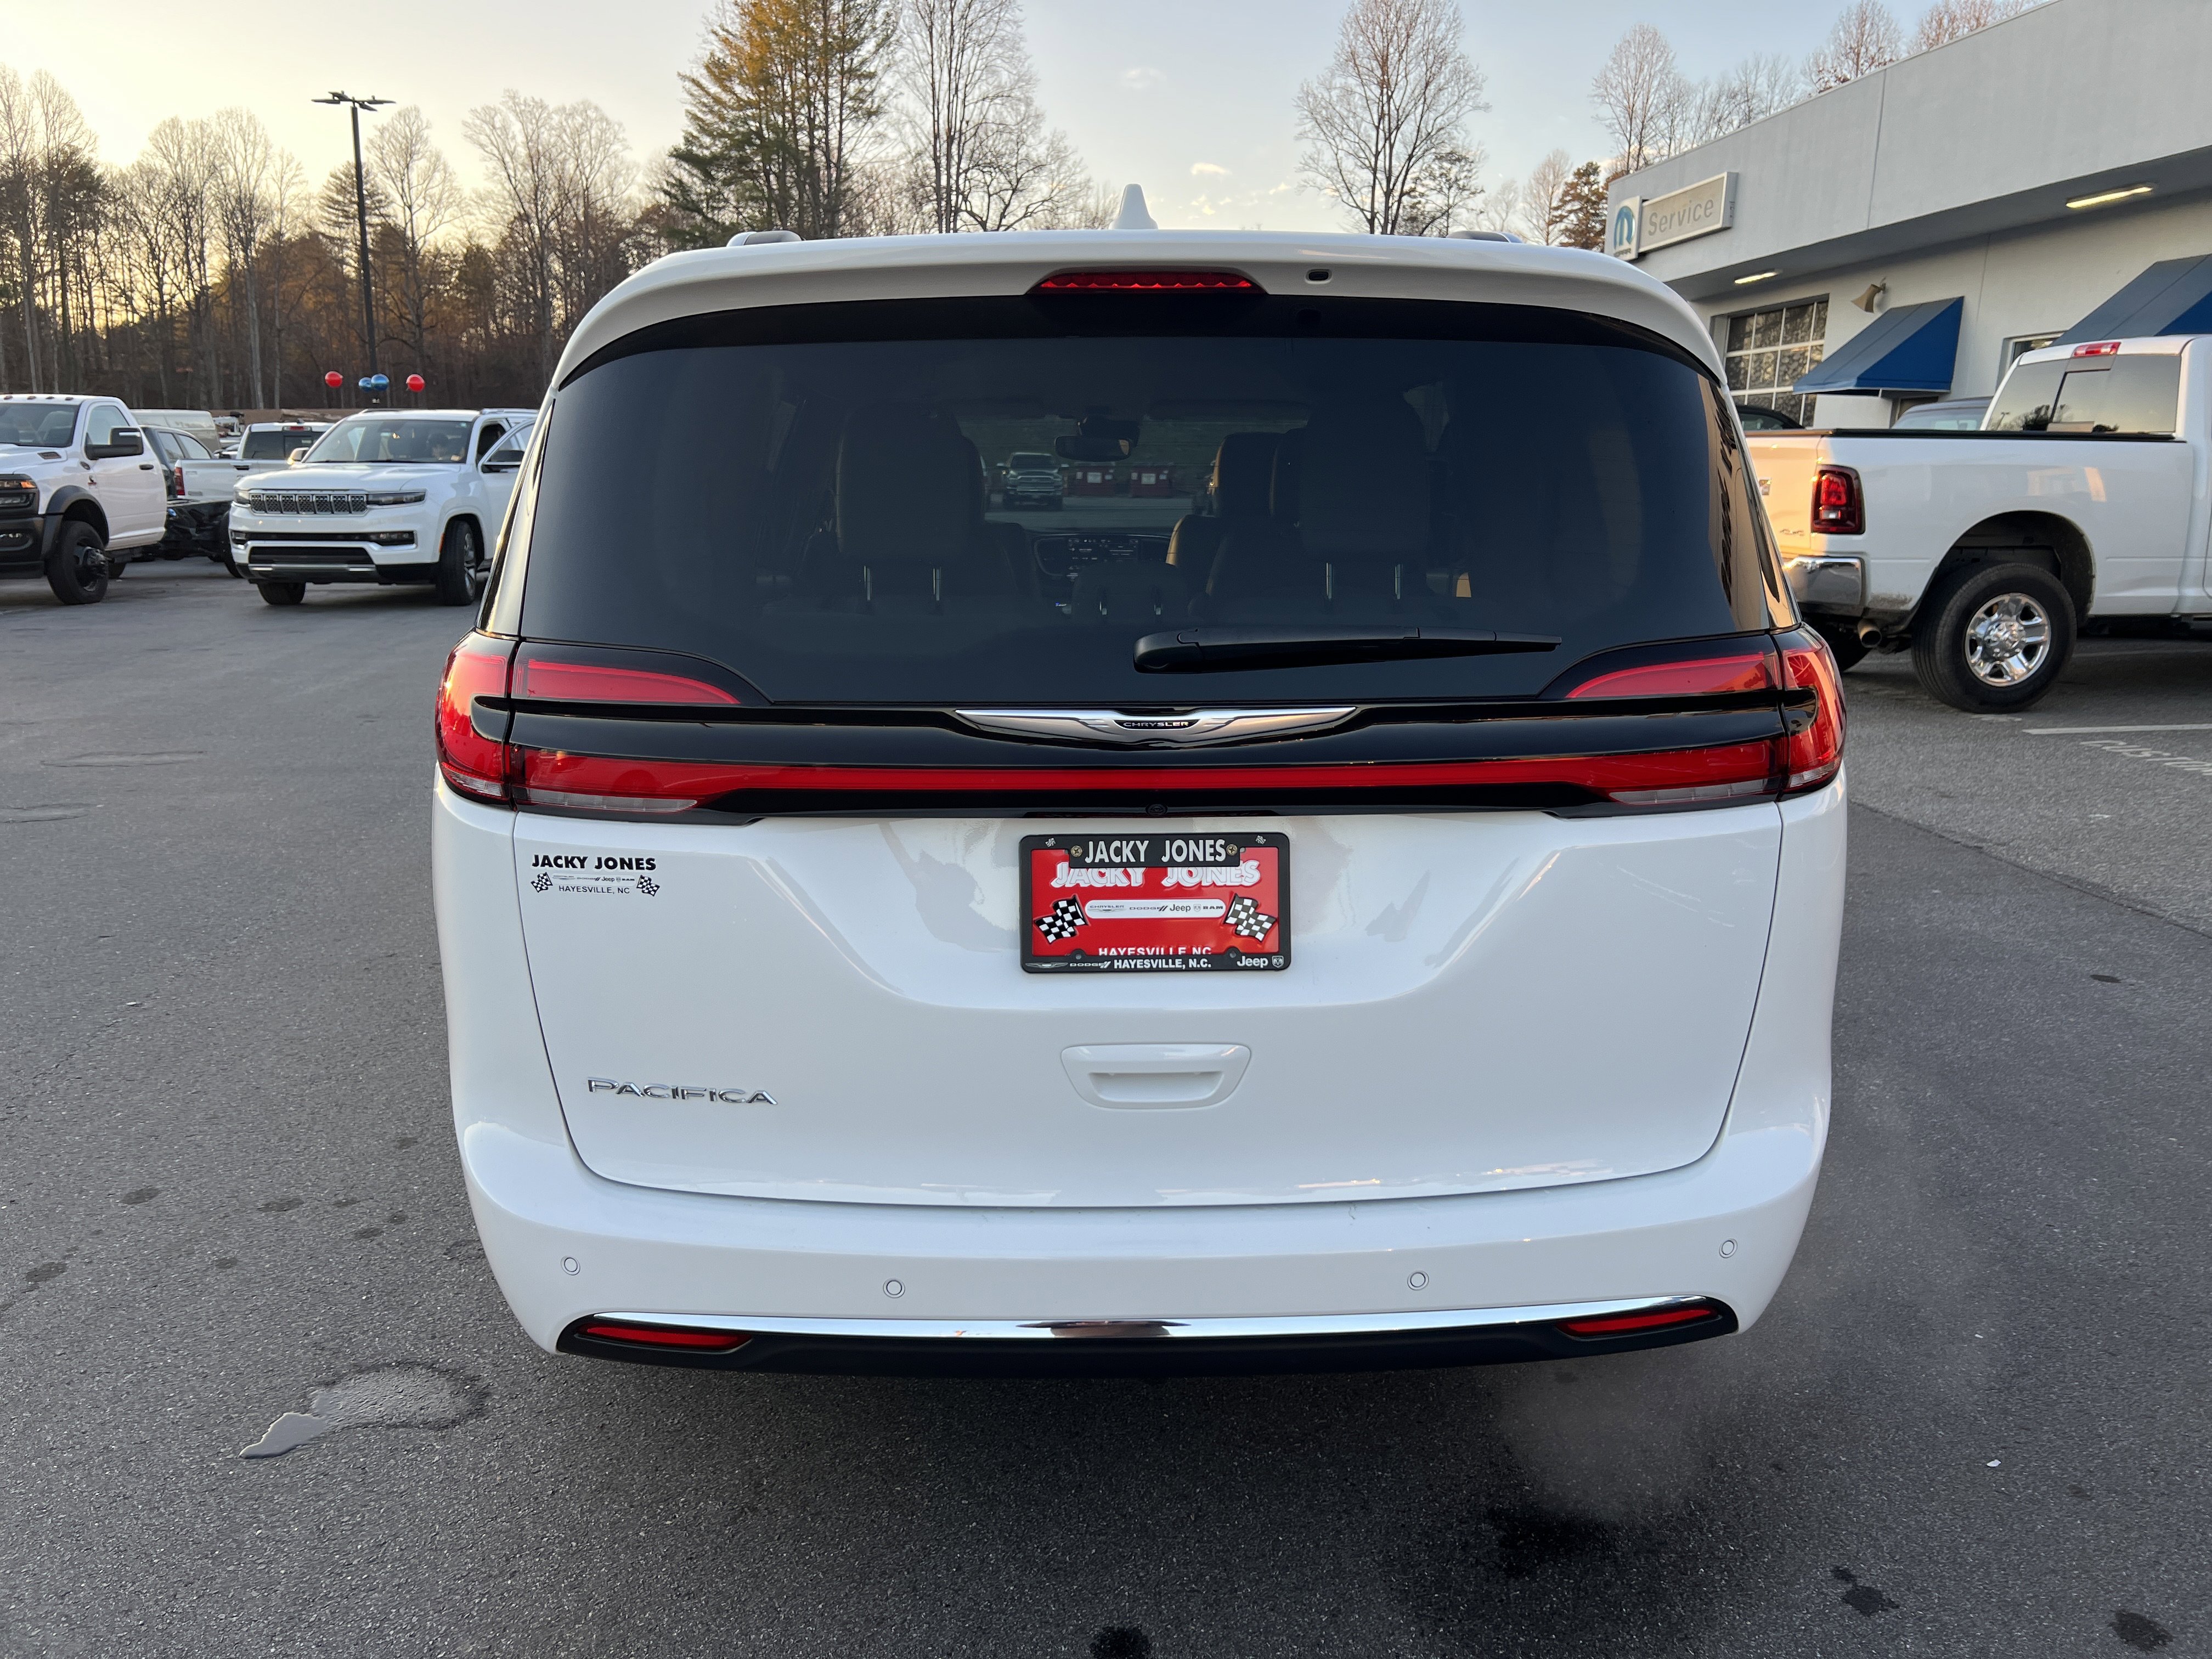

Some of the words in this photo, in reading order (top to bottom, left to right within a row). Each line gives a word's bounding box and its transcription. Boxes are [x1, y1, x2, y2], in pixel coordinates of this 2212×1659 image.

[1648, 199, 1713, 236] Service
[1085, 840, 1149, 863] JACKY
[1161, 839, 1226, 862] JONES
[532, 855, 588, 868] JACKY
[595, 857, 656, 870] JONES
[1050, 861, 1147, 888] JACKY
[1161, 860, 1260, 887] JONES
[559, 885, 614, 894] HAYESVILLE,
[1170, 904, 1191, 912] Jeep
[1114, 958, 1185, 969] HAYESVILLE,
[1189, 958, 1211, 968] N.C.
[1237, 955, 1268, 968] Jeep
[588, 1076, 778, 1105] PACIFICA
